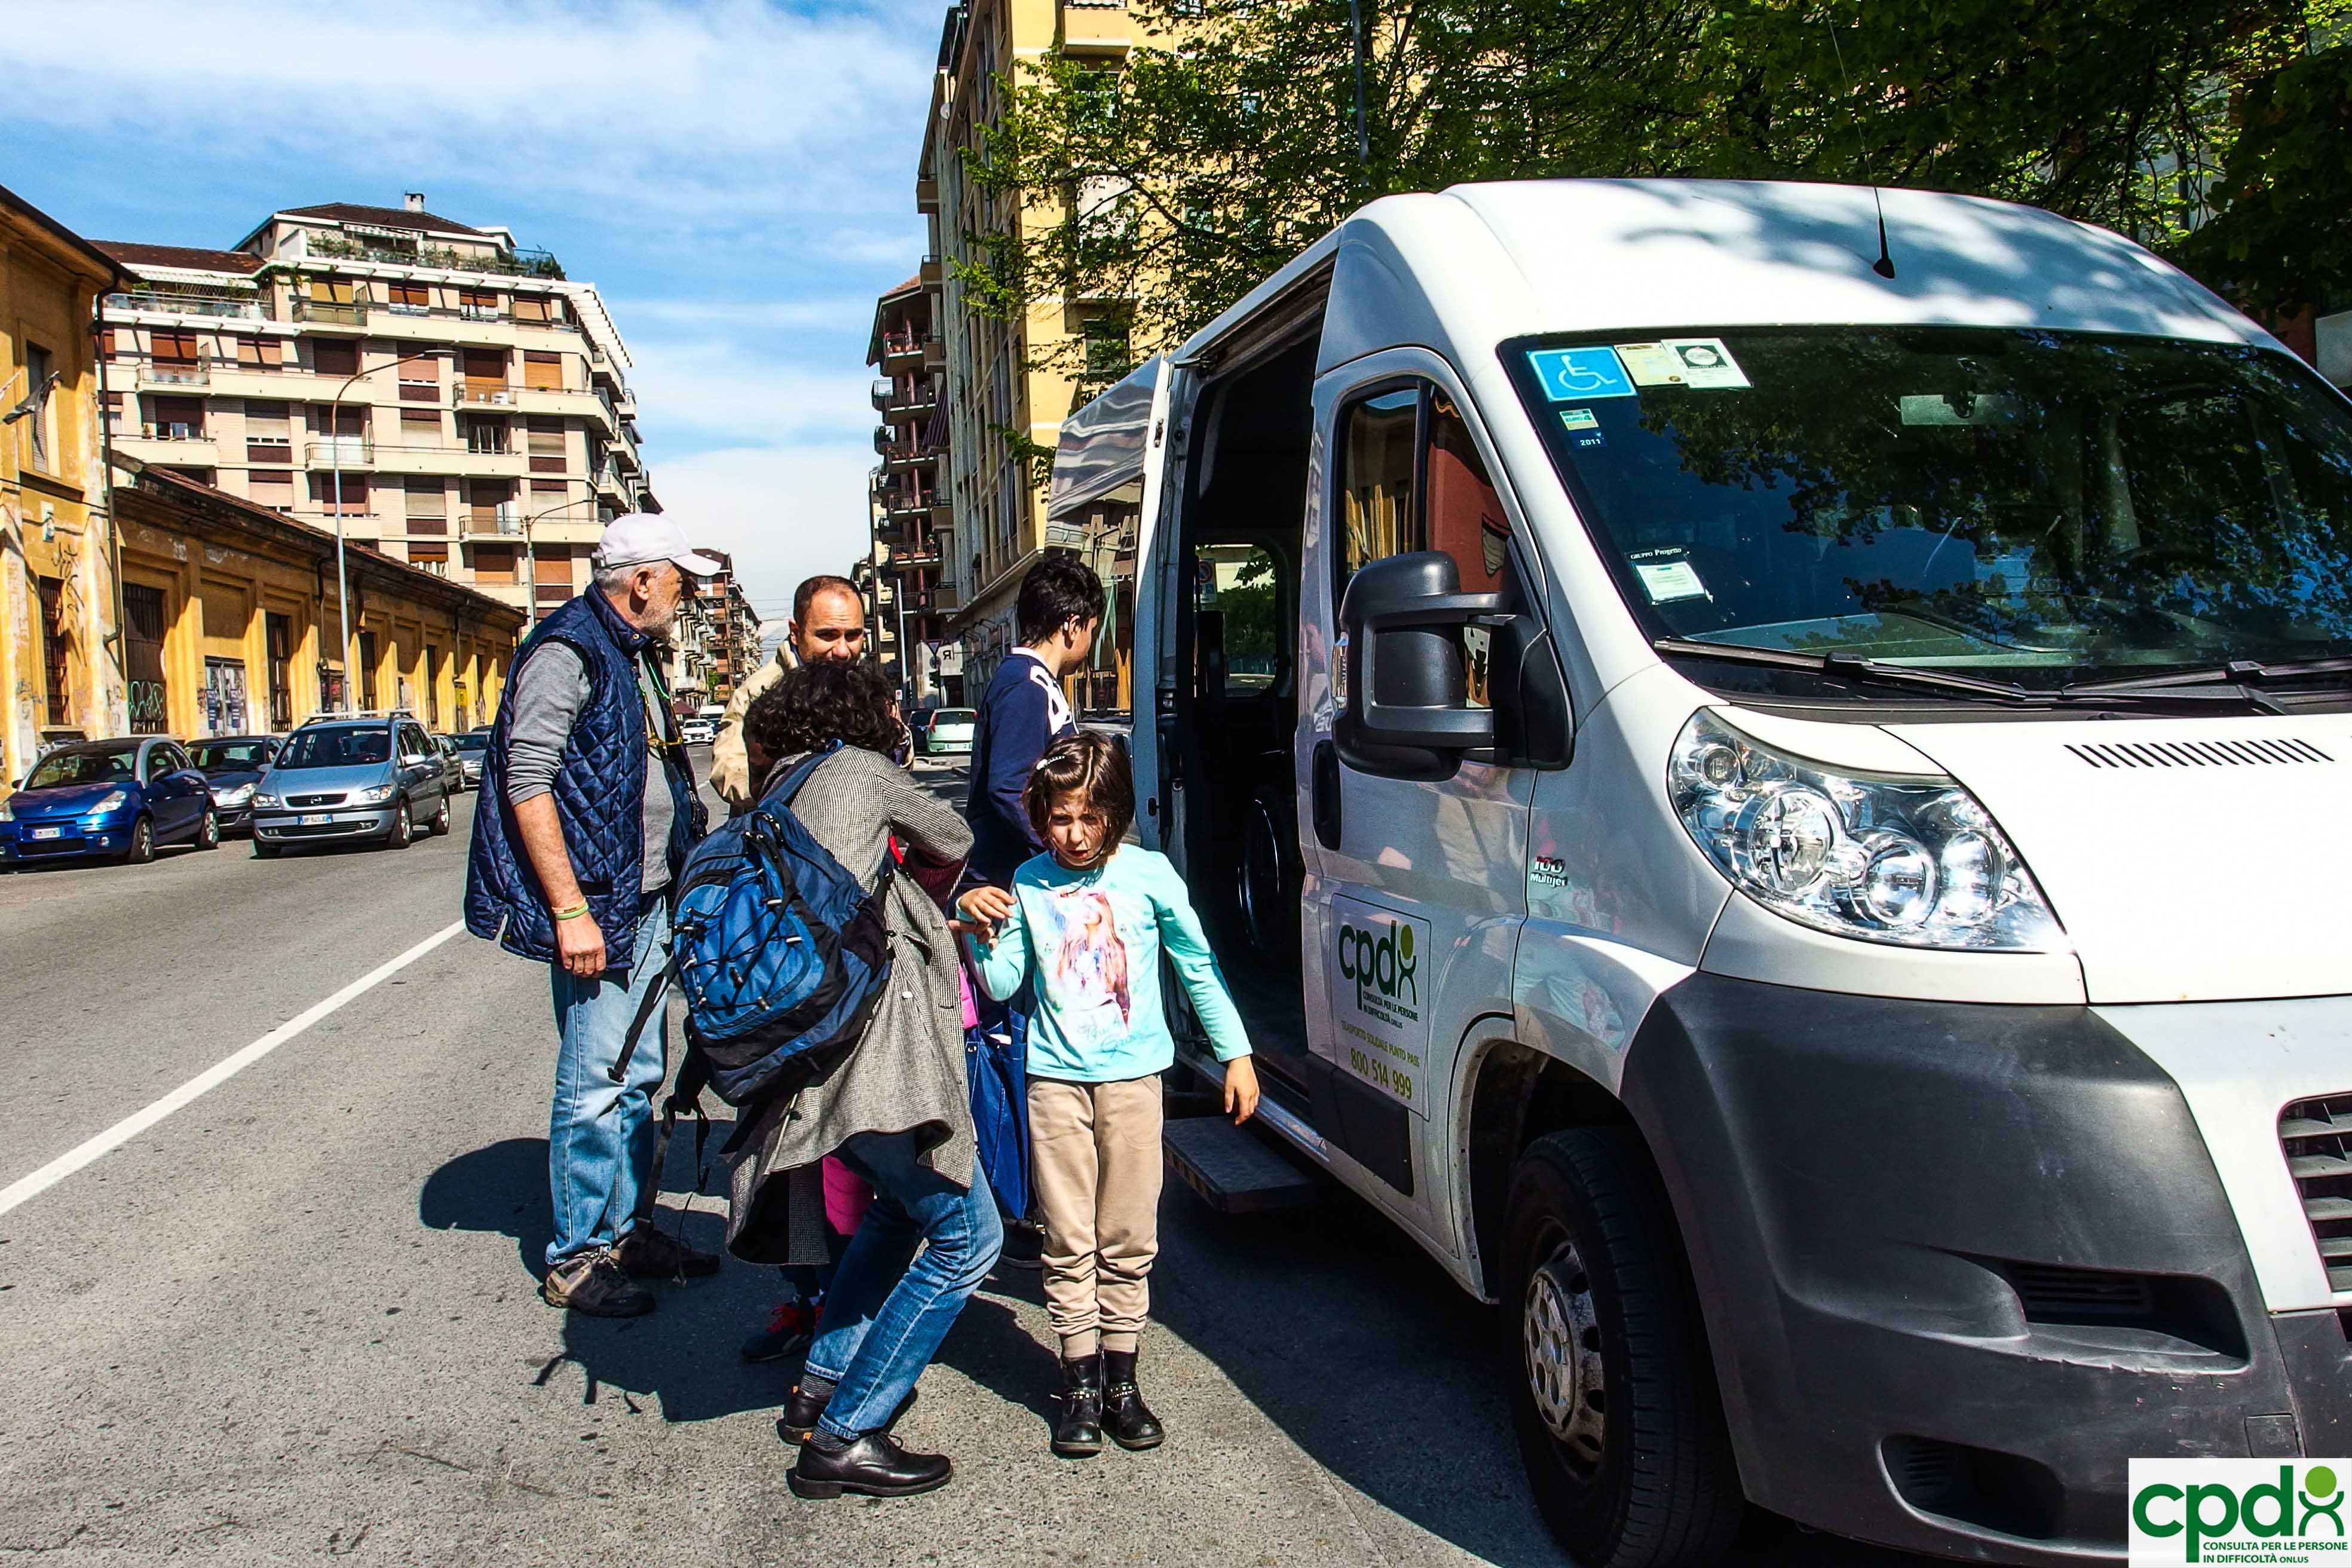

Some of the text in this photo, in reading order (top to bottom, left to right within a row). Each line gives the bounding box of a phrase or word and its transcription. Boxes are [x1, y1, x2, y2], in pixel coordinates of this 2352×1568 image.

[1388, 1043, 1406, 1061] PUNTO
[1350, 1046, 1411, 1100] 800 514 999
